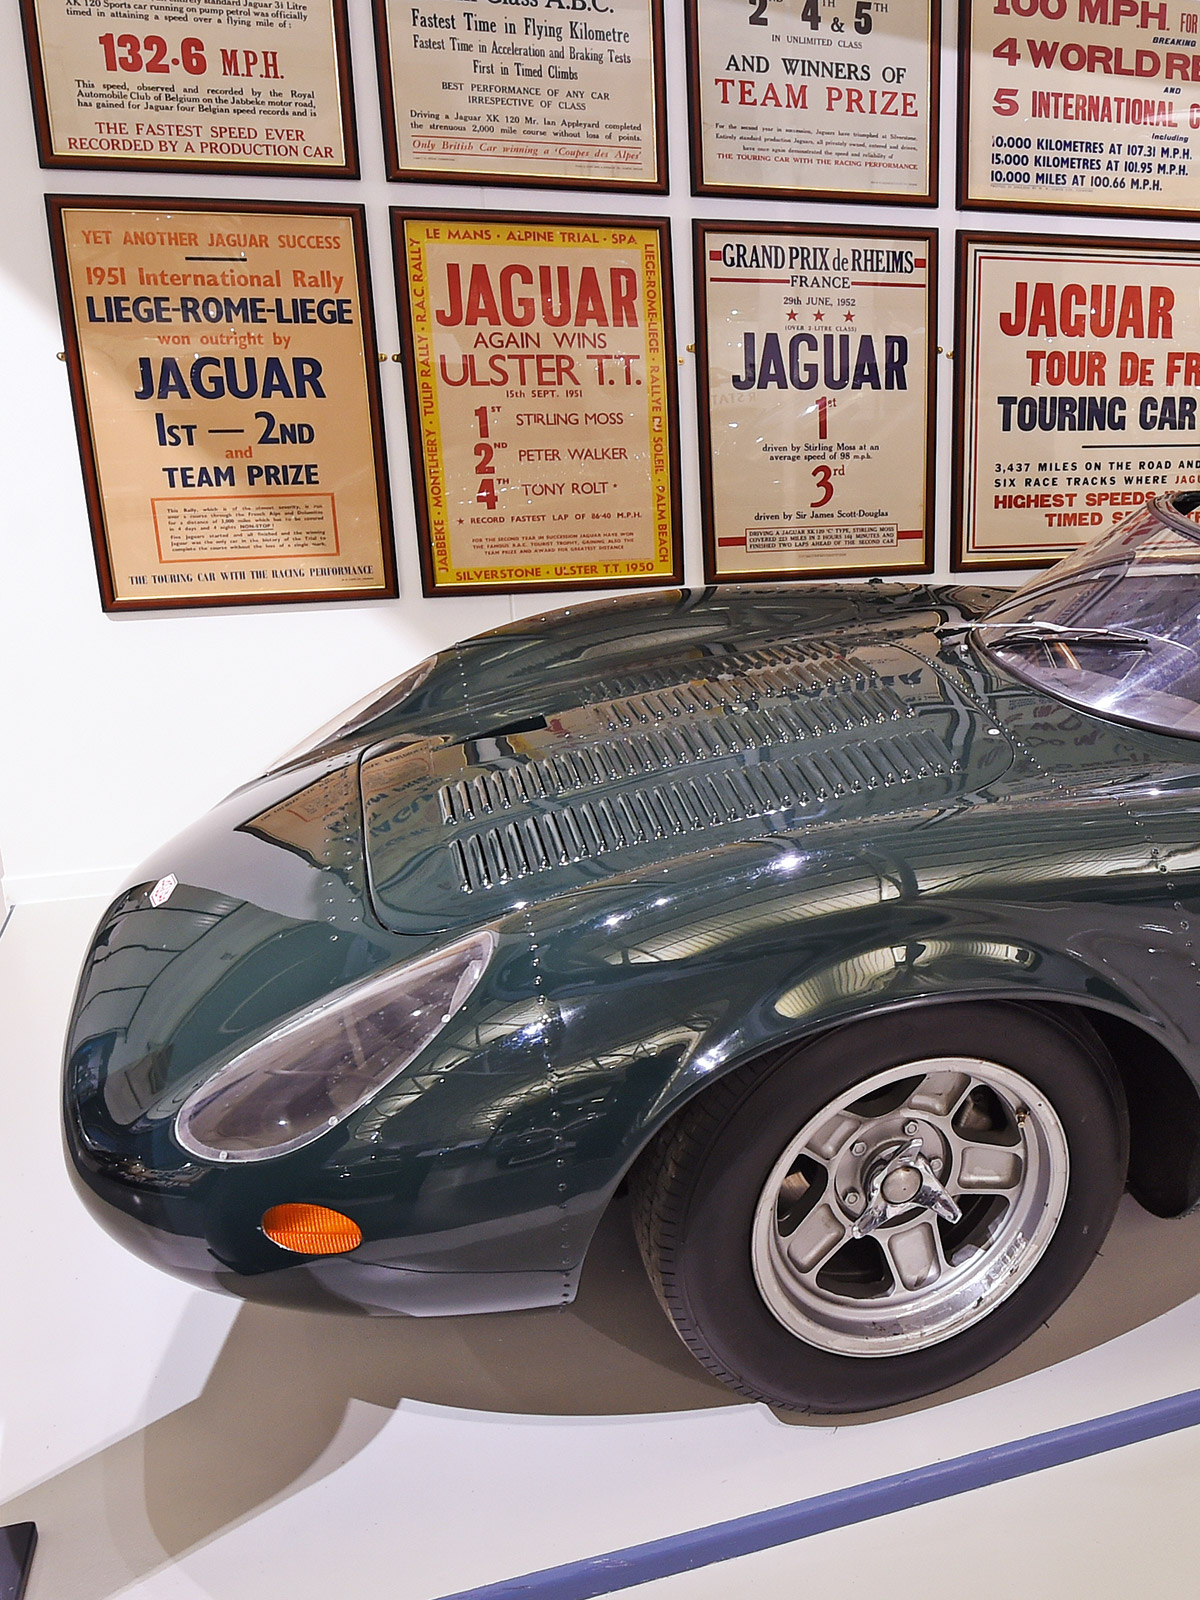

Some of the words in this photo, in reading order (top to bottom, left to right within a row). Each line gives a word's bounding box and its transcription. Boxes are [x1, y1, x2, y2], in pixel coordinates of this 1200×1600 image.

[411, 8, 456, 30] Fastest
[464, 13, 497, 32] Time
[505, 16, 516, 34] in
[524, 18, 563, 41] Flying
[569, 21, 630, 43] Kilometre
[1078, 0, 1170, 31] M.P.H.
[1180, 13, 1198, 34] FOR
[771, 34, 781, 42] IN
[787, 35, 832, 46] UNLIMITED
[838, 40, 863, 49] CLASS
[221, 48, 284, 80] M.P.H.
[726, 54, 770, 73] AND
[781, 58, 870, 81] WINNERS
[882, 67, 907, 84] OF
[993, 38, 1020, 66] 4
[1027, 39, 1160, 78] WORLD
[714, 78, 808, 110] TEAM
[826, 86, 919, 117] PRIZE
[992, 88, 1019, 116] 5
[1032, 91, 1178, 127] INTERNATIONAL
[95, 122, 128, 135] THE
[136, 123, 202, 138] FASTEST
[211, 126, 258, 140] SPEED
[266, 128, 305, 142] EVER
[1151, 133, 1189, 143] Including
[69, 138, 154, 152] RECORDED
[159, 140, 178, 153] BY
[185, 142, 196, 153] A
[200, 142, 299, 157] PRODUCTION
[304, 146, 334, 159] CAR
[81, 230, 112, 245] YET
[123, 231, 199, 246] ANOTHER
[208, 233, 270, 248] JAGUAR
[278, 235, 341, 250] SUCCESS
[426, 228, 440, 239] LE
[447, 229, 492, 241] MANS
[506, 231, 554, 242] ALPINE
[559, 232, 599, 244] TRIAL
[409, 238, 423, 283] RALLY
[723, 243, 785, 269] GRAND
[788, 247, 830, 270] PRIX
[832, 250, 849, 271] de
[851, 249, 914, 274] RHEIMS
[86, 266, 126, 285] 1951
[139, 267, 281, 288] International
[293, 270, 344, 293] Rally
[790, 275, 850, 288] FRANCE
[86, 296, 353, 324] LIEGE-ROME-LIEGE
[413, 286, 429, 322] R.A.C.
[435, 263, 639, 328] JAGUAR
[783, 297, 802, 305] 29th
[806, 297, 833, 306] JUNE,
[837, 298, 855, 306] 1952
[999, 282, 1175, 339] JAGUAR
[157, 334, 191, 346] won
[200, 333, 264, 349] outright
[273, 333, 291, 349] by
[473, 332, 540, 349] AGAIN
[553, 332, 607, 349] WINS
[440, 354, 581, 387] ULSTER
[587, 355, 642, 386] T.T.
[732, 332, 908, 390] JAGUAR
[1026, 351, 1106, 386] TOUR
[134, 357, 327, 400] JAGUAR
[506, 389, 525, 398] 15th
[531, 389, 559, 398] SEPT.
[565, 389, 583, 398] 1951
[516, 413, 579, 426] STIRLING
[585, 413, 623, 424] MOSS
[998, 396, 1126, 431] TOURING
[1139, 397, 1198, 431] CAR
[225, 446, 253, 459] and
[518, 450, 561, 461] PETER
[568, 448, 628, 460] WALKER
[162, 466, 235, 488] TEAM
[247, 464, 320, 485] PRIZE
[425, 429, 443, 508] MONTLHERY
[522, 483, 565, 496] TONY
[571, 482, 608, 494] ROLT
[655, 486, 667, 521] PALM
[754, 513, 780, 521] driven
[783, 512, 793, 520] by
[796, 511, 807, 519] Sir
[810, 511, 834, 519] James
[837, 510, 888, 519] Scott-Douglas
[433, 519, 449, 573] JABBEKE
[658, 523, 668, 562] BEACH
[129, 575, 148, 585] THE
[152, 572, 193, 584] TOURING
[197, 572, 216, 582] CAR
[221, 571, 246, 580] WITH
[250, 570, 268, 579] THE
[272, 568, 305, 578] RACING
[309, 565, 373, 577] PERFORMANCE
